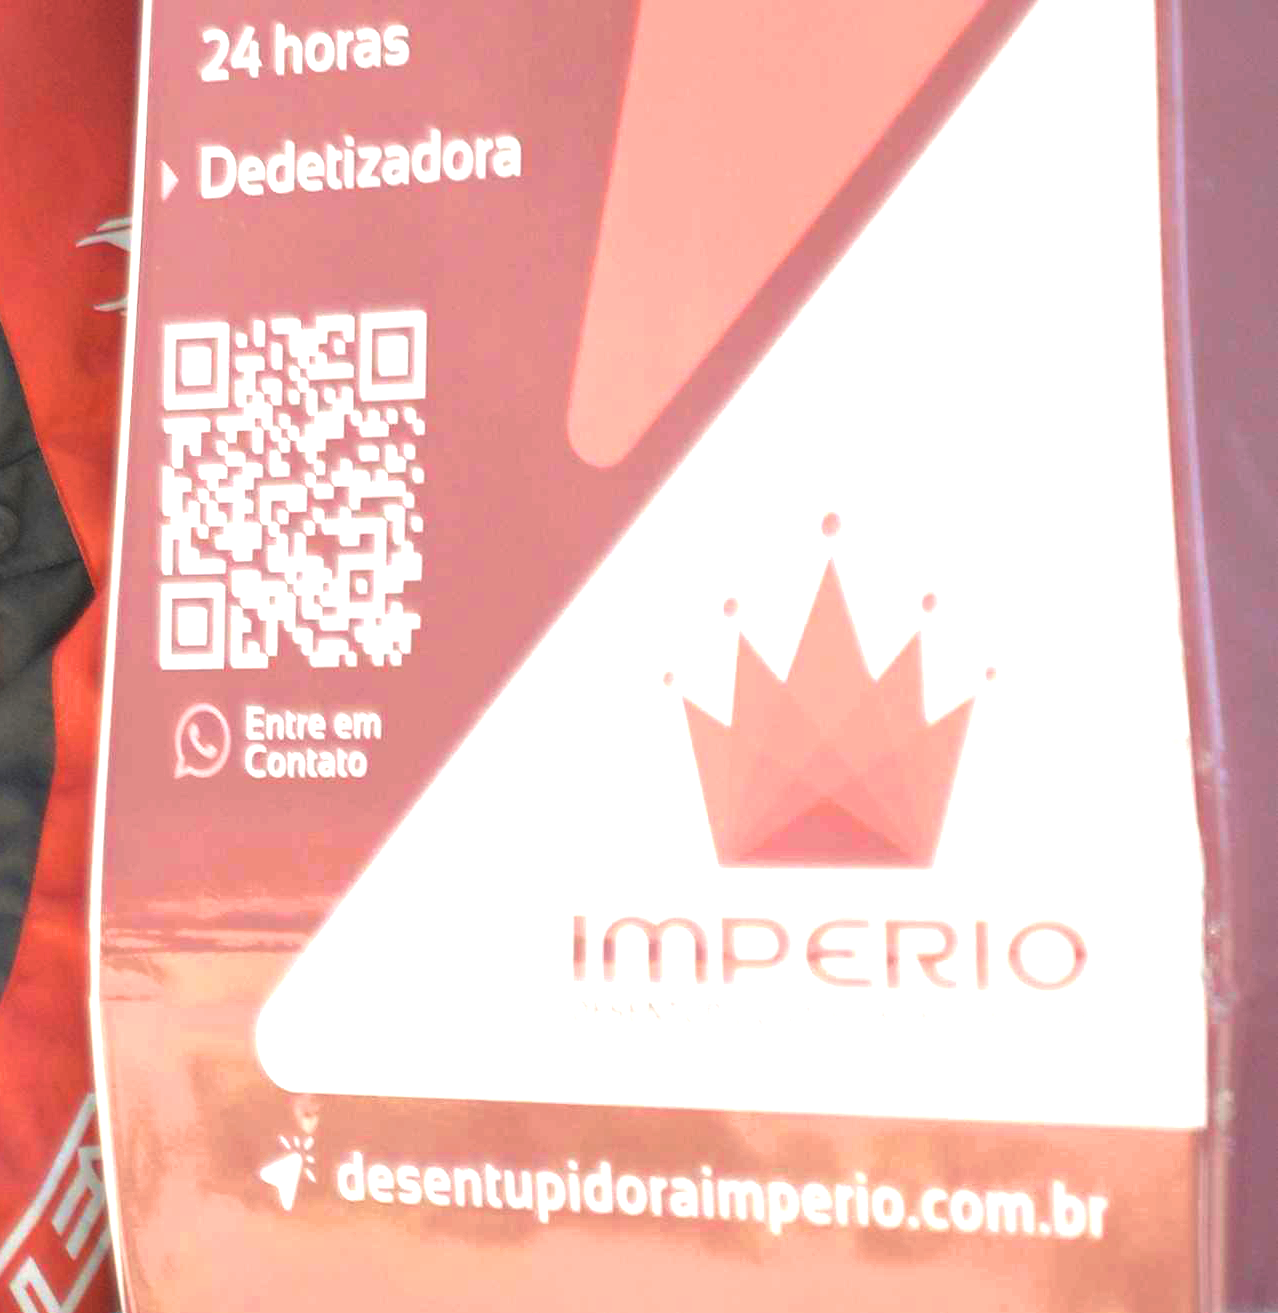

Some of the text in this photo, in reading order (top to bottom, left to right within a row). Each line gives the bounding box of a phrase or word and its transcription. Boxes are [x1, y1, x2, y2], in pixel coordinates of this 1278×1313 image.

[200, 22, 410, 82] 24 horas
[200, 127, 523, 200] Dedetizadora
[245, 705, 383, 741] Entre em
[244, 743, 368, 779] Contato
[572, 915, 1088, 990] IMPERIO
[337, 1151, 1109, 1237] desentupidoraimperio.com.br
